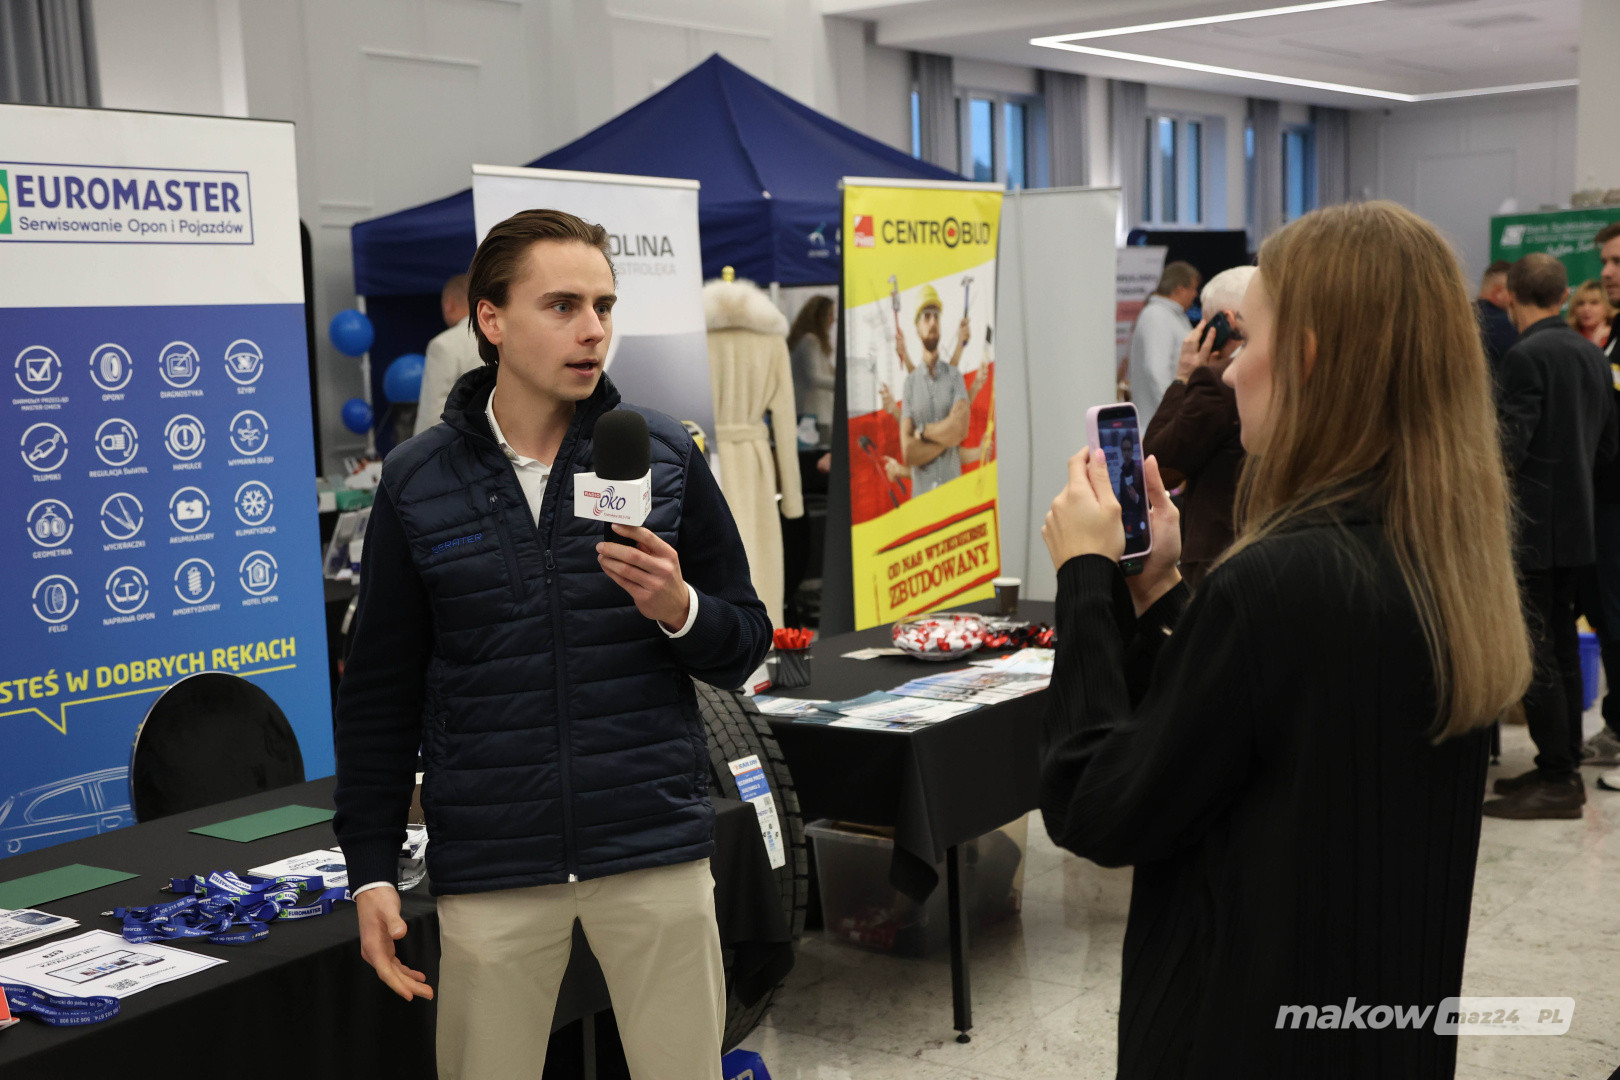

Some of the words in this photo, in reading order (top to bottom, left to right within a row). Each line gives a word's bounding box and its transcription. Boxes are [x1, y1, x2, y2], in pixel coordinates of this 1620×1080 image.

[15, 174, 242, 213] EUROMASTER
[19, 217, 123, 232] Serwisowanie
[127, 219, 167, 236] Opon
[171, 220, 175, 233] i
[179, 220, 243, 236] Pojazdów
[882, 216, 991, 248] CENTROBUD
[160, 389, 204, 399] DIAGNOSTYKA
[236, 386, 256, 395] SZYBY
[102, 394, 125, 402] OPONY
[172, 462, 202, 471] HAMULCE
[599, 495, 626, 510] OKO
[234, 525, 277, 537] KLIMATYZACJA
[169, 532, 215, 544] AKUMULATORY
[103, 540, 146, 551] WYCIERACZKI
[32, 548, 73, 559] GEOMETRIA
[889, 542, 989, 610] ZBUDOWANY
[102, 614, 136, 626] NAPRAWA
[136, 612, 156, 622] OPON
[48, 624, 68, 634] FELGI
[0, 669, 60, 704] STEŚ
[66, 669, 89, 692] W
[96, 651, 206, 689] DOBRYCH
[212, 636, 296, 671] RĘKACH
[288, 907, 321, 916] EUROMASTER
